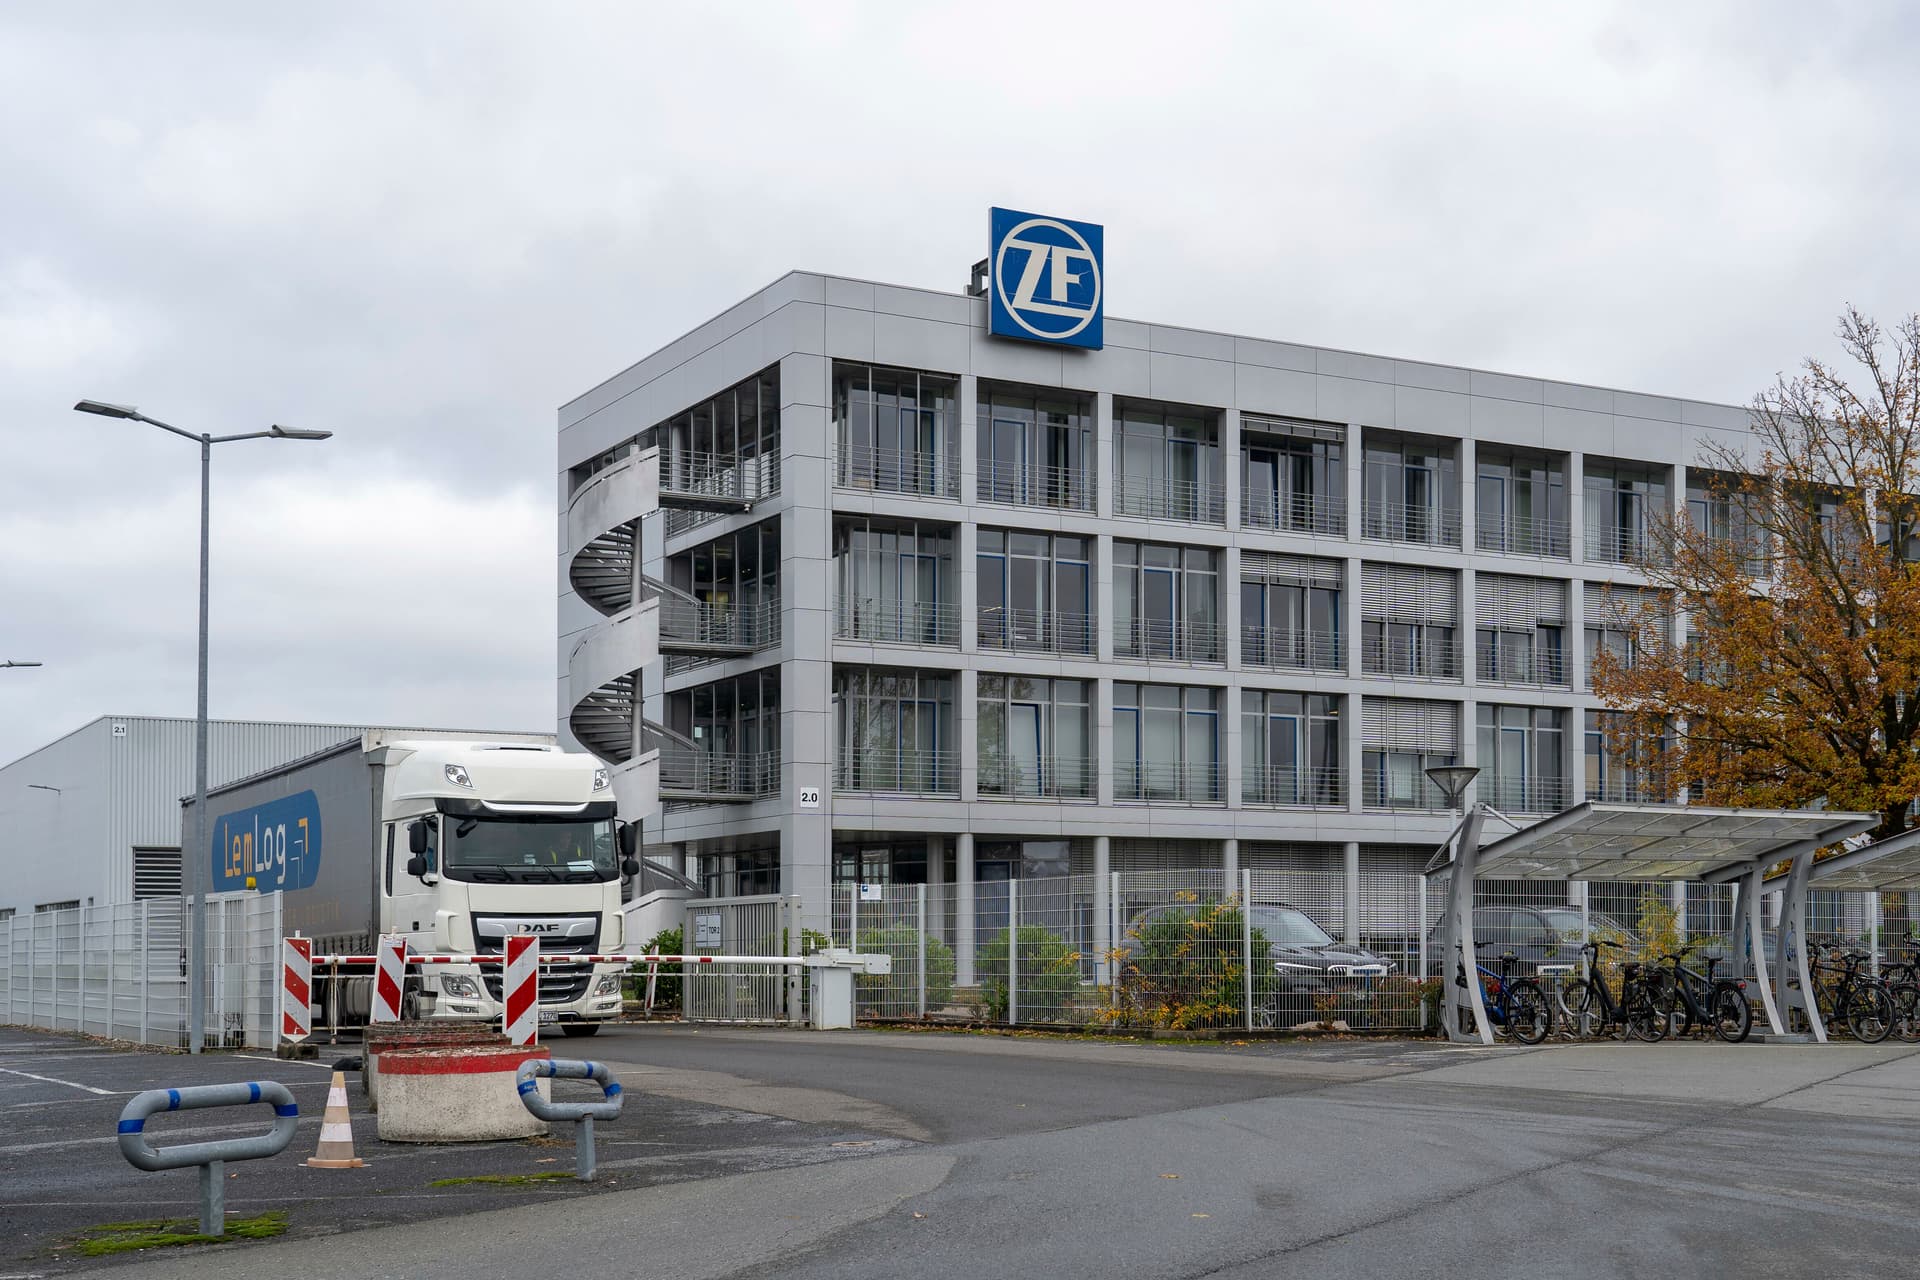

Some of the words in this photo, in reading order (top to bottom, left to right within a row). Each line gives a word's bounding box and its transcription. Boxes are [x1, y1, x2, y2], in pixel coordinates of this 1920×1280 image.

[1003, 236, 1094, 321] ZF
[114, 726, 125, 734] 2.1
[801, 792, 818, 803] 2.0
[224, 814, 286, 885] LemLog
[517, 923, 560, 933] DAF
